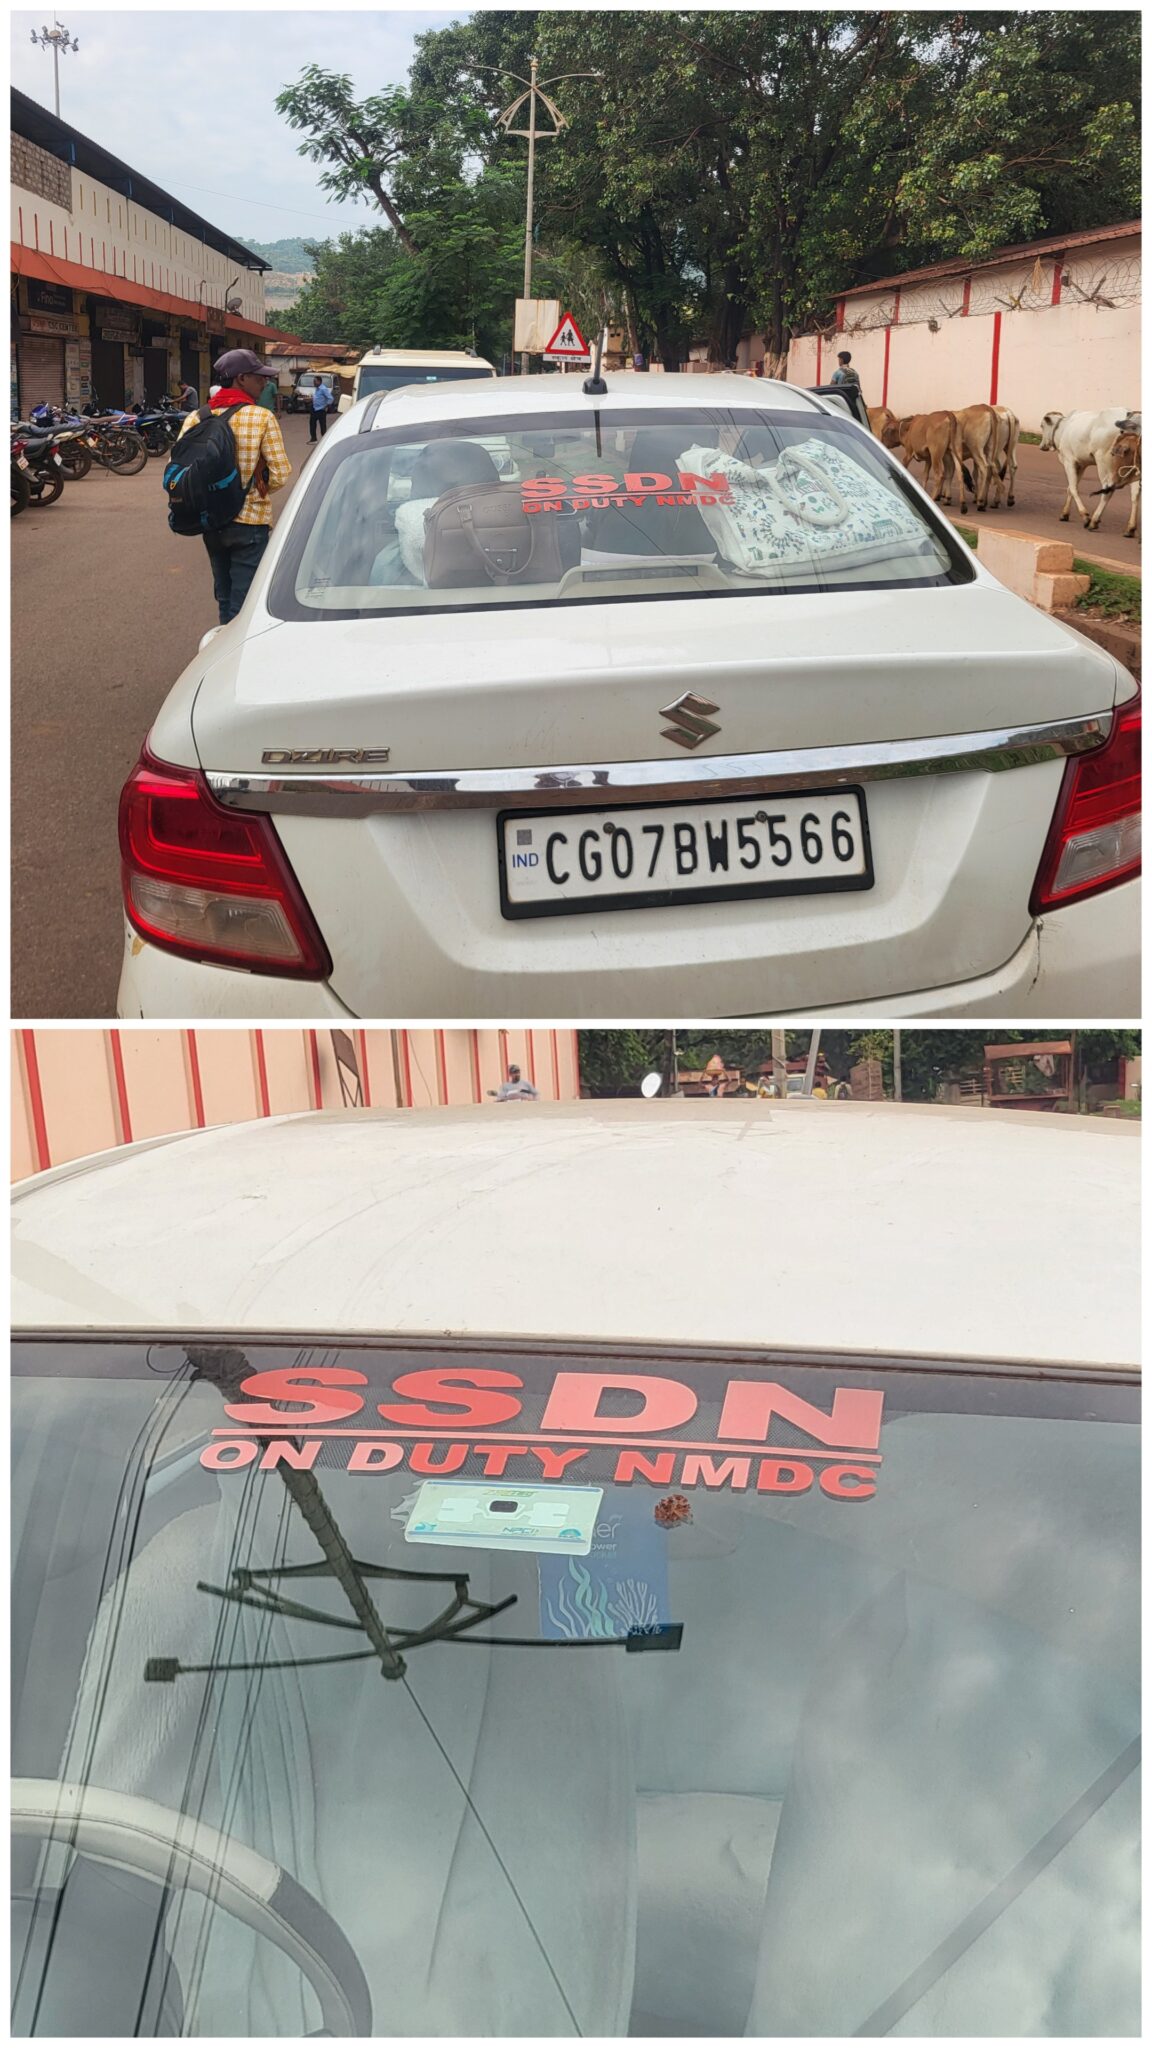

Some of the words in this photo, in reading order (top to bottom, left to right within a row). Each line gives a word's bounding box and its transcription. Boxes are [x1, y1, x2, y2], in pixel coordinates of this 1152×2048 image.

[520, 472, 730, 498] SSDN
[523, 501, 562, 513] ON
[572, 496, 646, 508] DUTY
[657, 494, 736, 507] NMDC
[261, 747, 390, 764] DZIRE
[512, 852, 539, 868] IND
[546, 811, 855, 885] CG07BW5566
[224, 1367, 885, 1449] SSDN
[200, 1440, 319, 1471] ON
[348, 1441, 590, 1478] DUTY
[614, 1451, 879, 1498] NMDC
